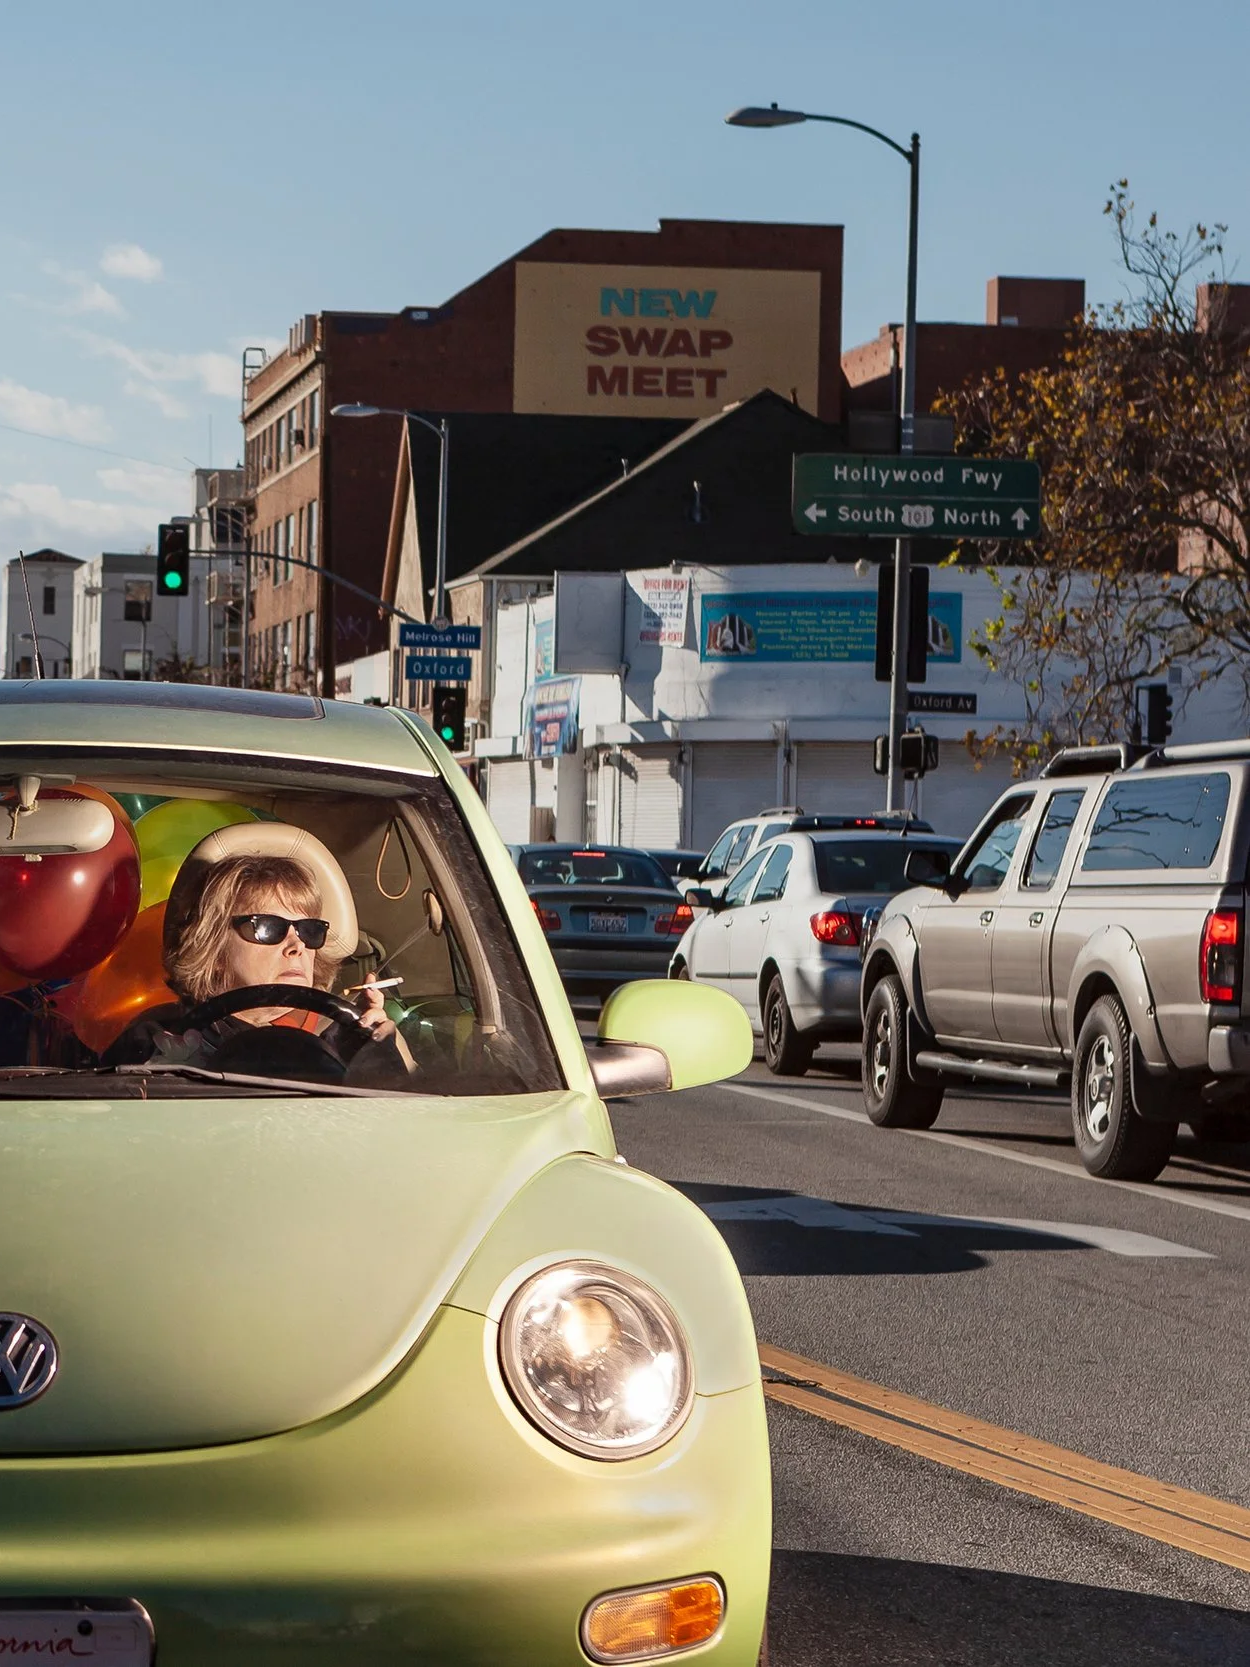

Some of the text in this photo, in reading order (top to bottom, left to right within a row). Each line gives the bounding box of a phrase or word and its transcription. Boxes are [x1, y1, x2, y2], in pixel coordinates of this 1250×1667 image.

[601, 287, 717, 319] NEW
[585, 325, 734, 358] SWAP
[586, 365, 727, 399] MEET
[834, 465, 1002, 491] Hollywood Fwy
[838, 505, 1000, 526] South 101 North
[405, 631, 476, 643] Melrose Hill
[413, 661, 464, 675] Oxford
[914, 696, 972, 709] Oxford Av
